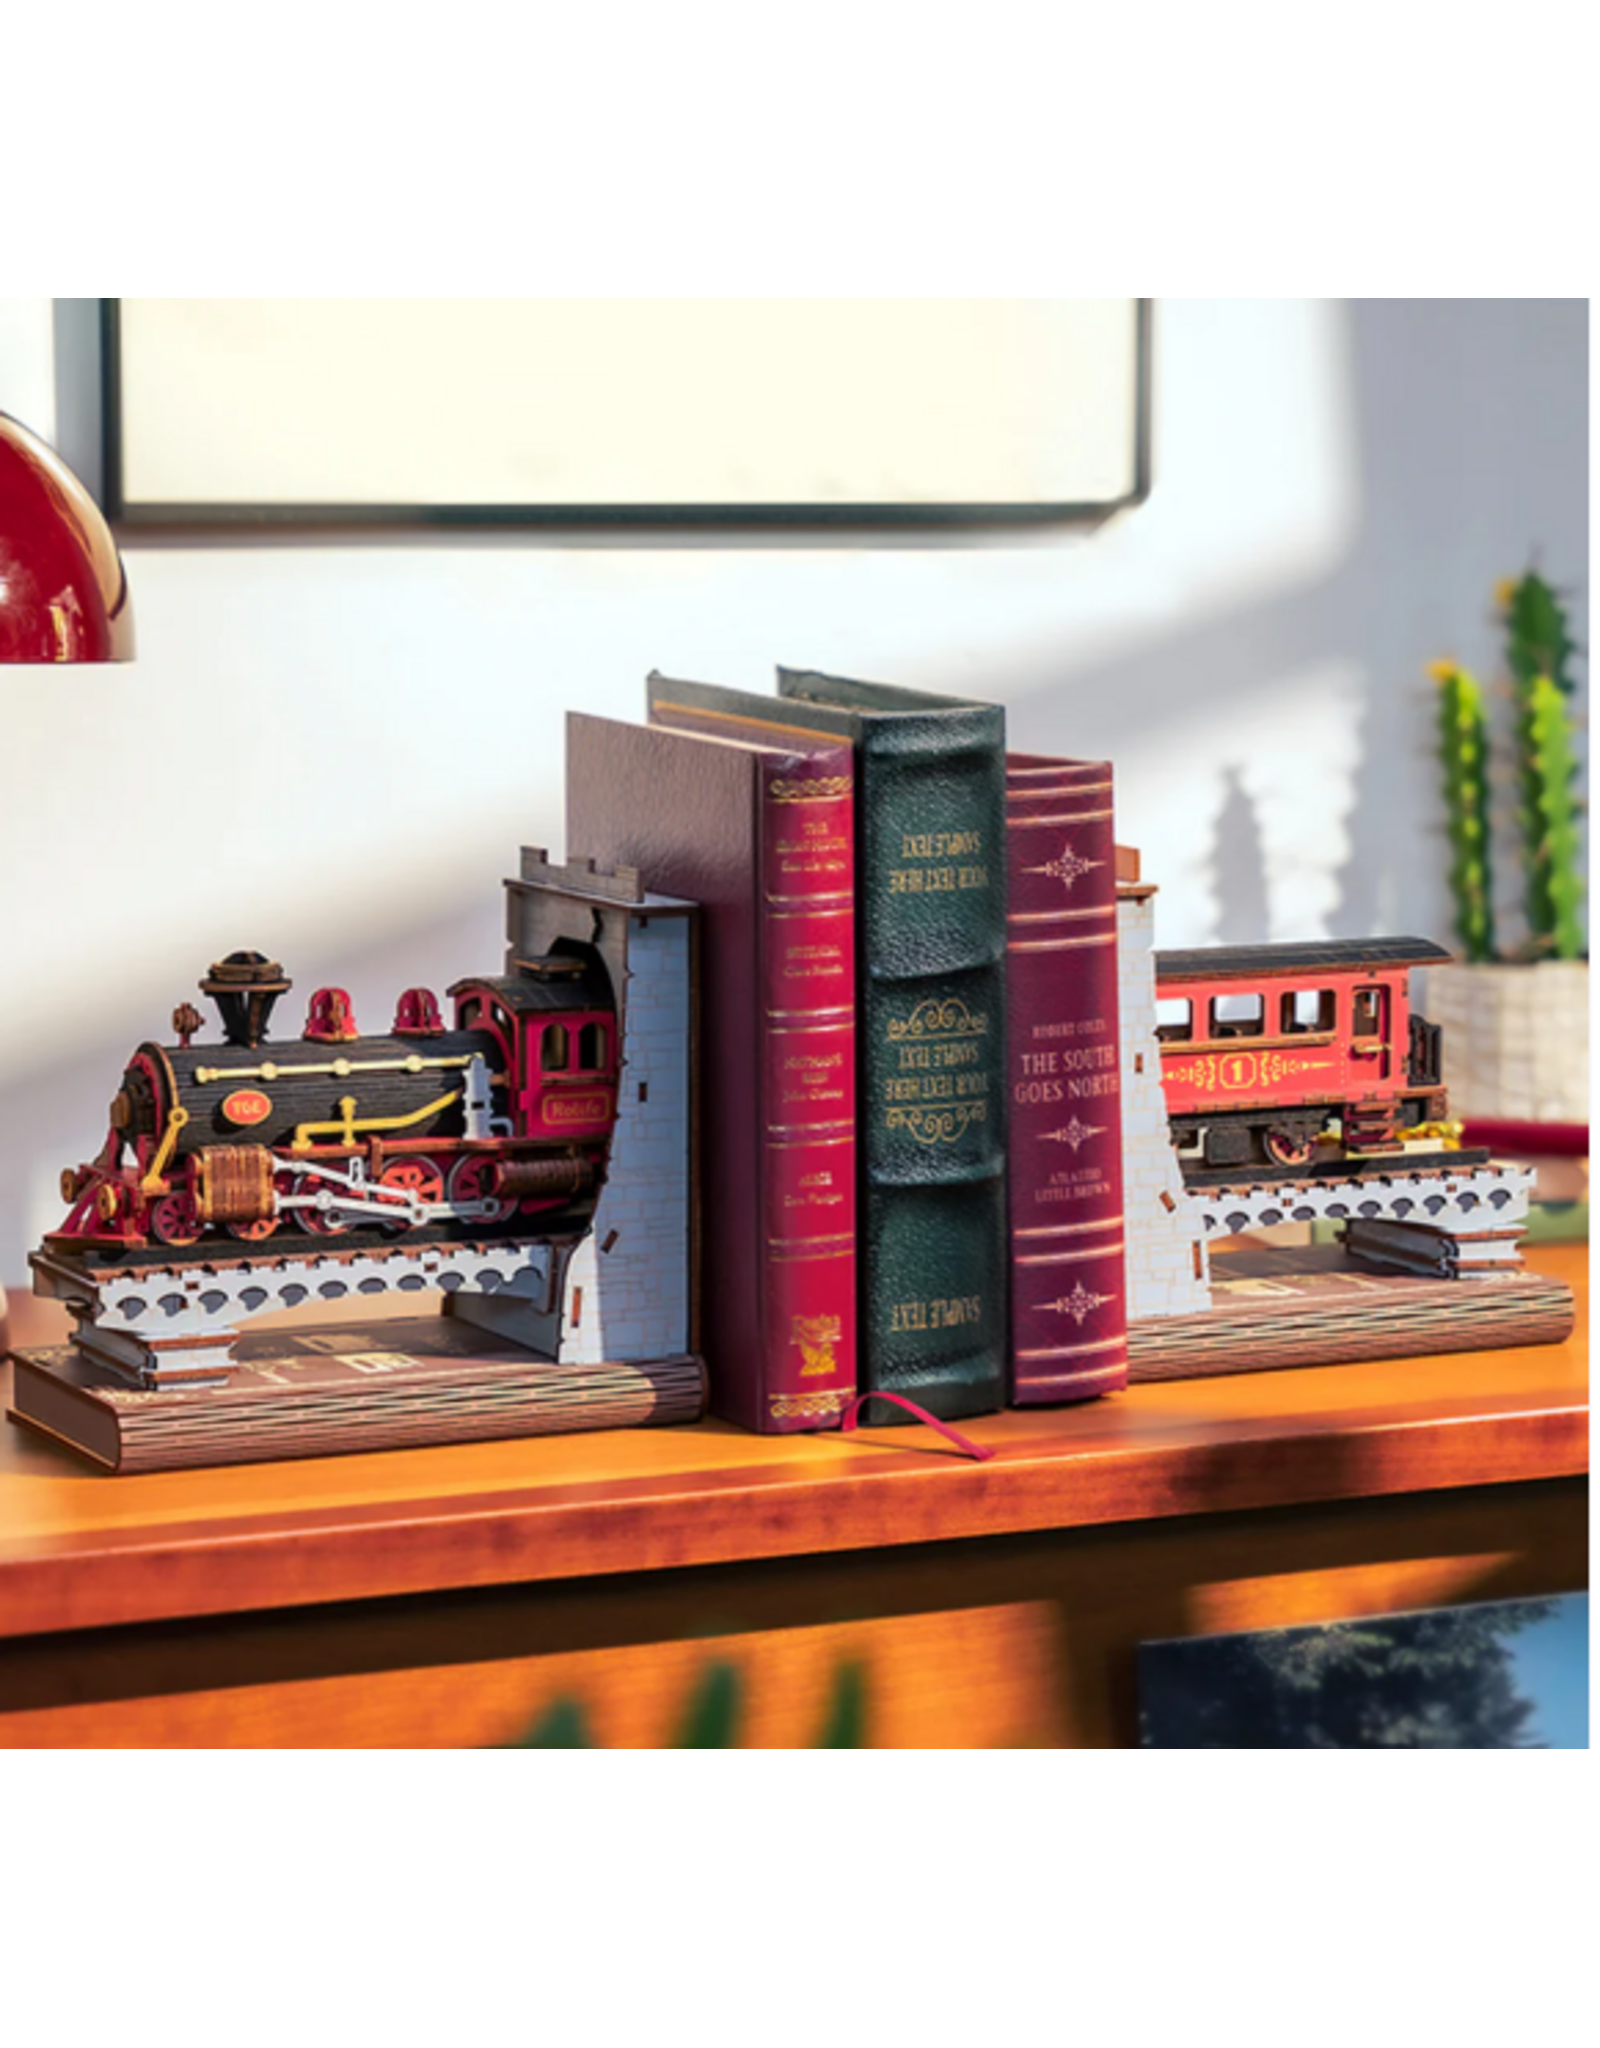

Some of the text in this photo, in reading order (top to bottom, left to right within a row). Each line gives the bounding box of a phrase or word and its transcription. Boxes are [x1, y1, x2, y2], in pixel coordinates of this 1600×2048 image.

[1021, 1044, 1115, 1074] THE SOUTH
[1230, 1060, 1243, 1082] 1
[1014, 1072, 1120, 1104] GOES NORTH
